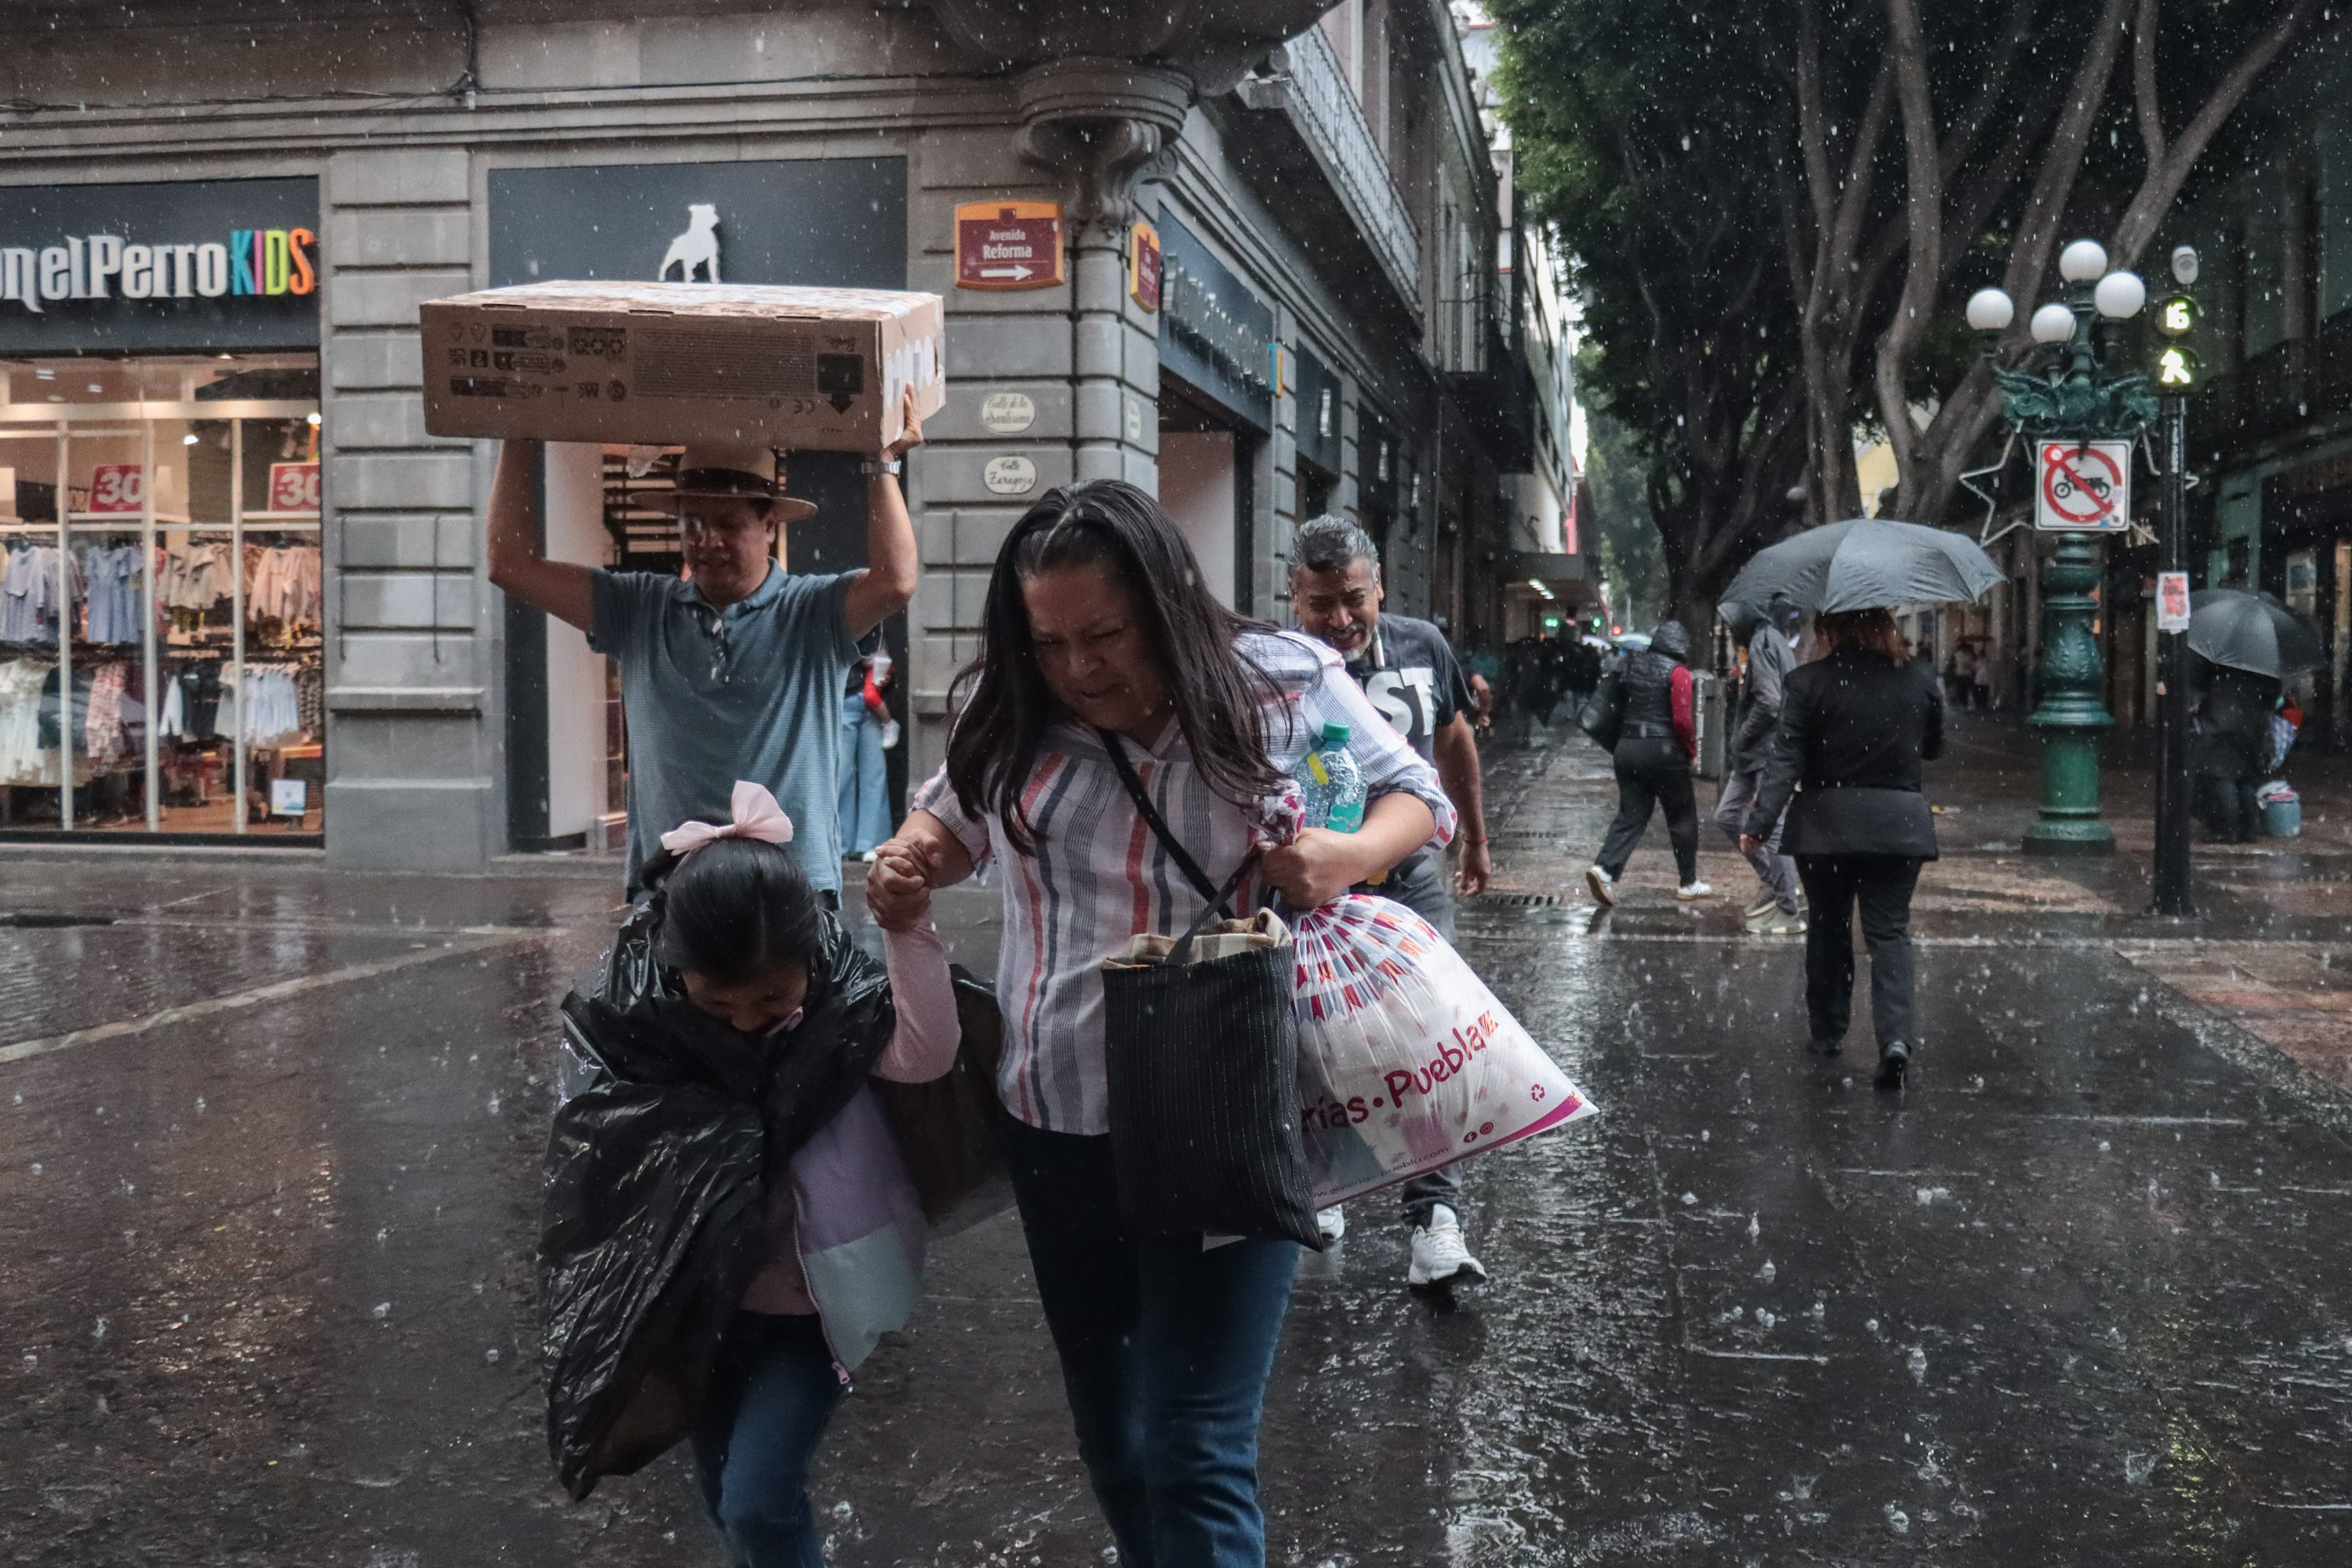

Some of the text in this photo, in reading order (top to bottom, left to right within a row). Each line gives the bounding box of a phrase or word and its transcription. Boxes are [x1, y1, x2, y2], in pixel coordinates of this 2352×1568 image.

[982, 243, 1033, 260] Reforma
[989, 229, 1026, 241] Avenida
[0, 228, 315, 313] nelPerro KIDS
[2166, 303, 2190, 329] 16
[1355, 667, 1434, 736] ST
[1301, 1025, 1486, 1133] rías Puebla
